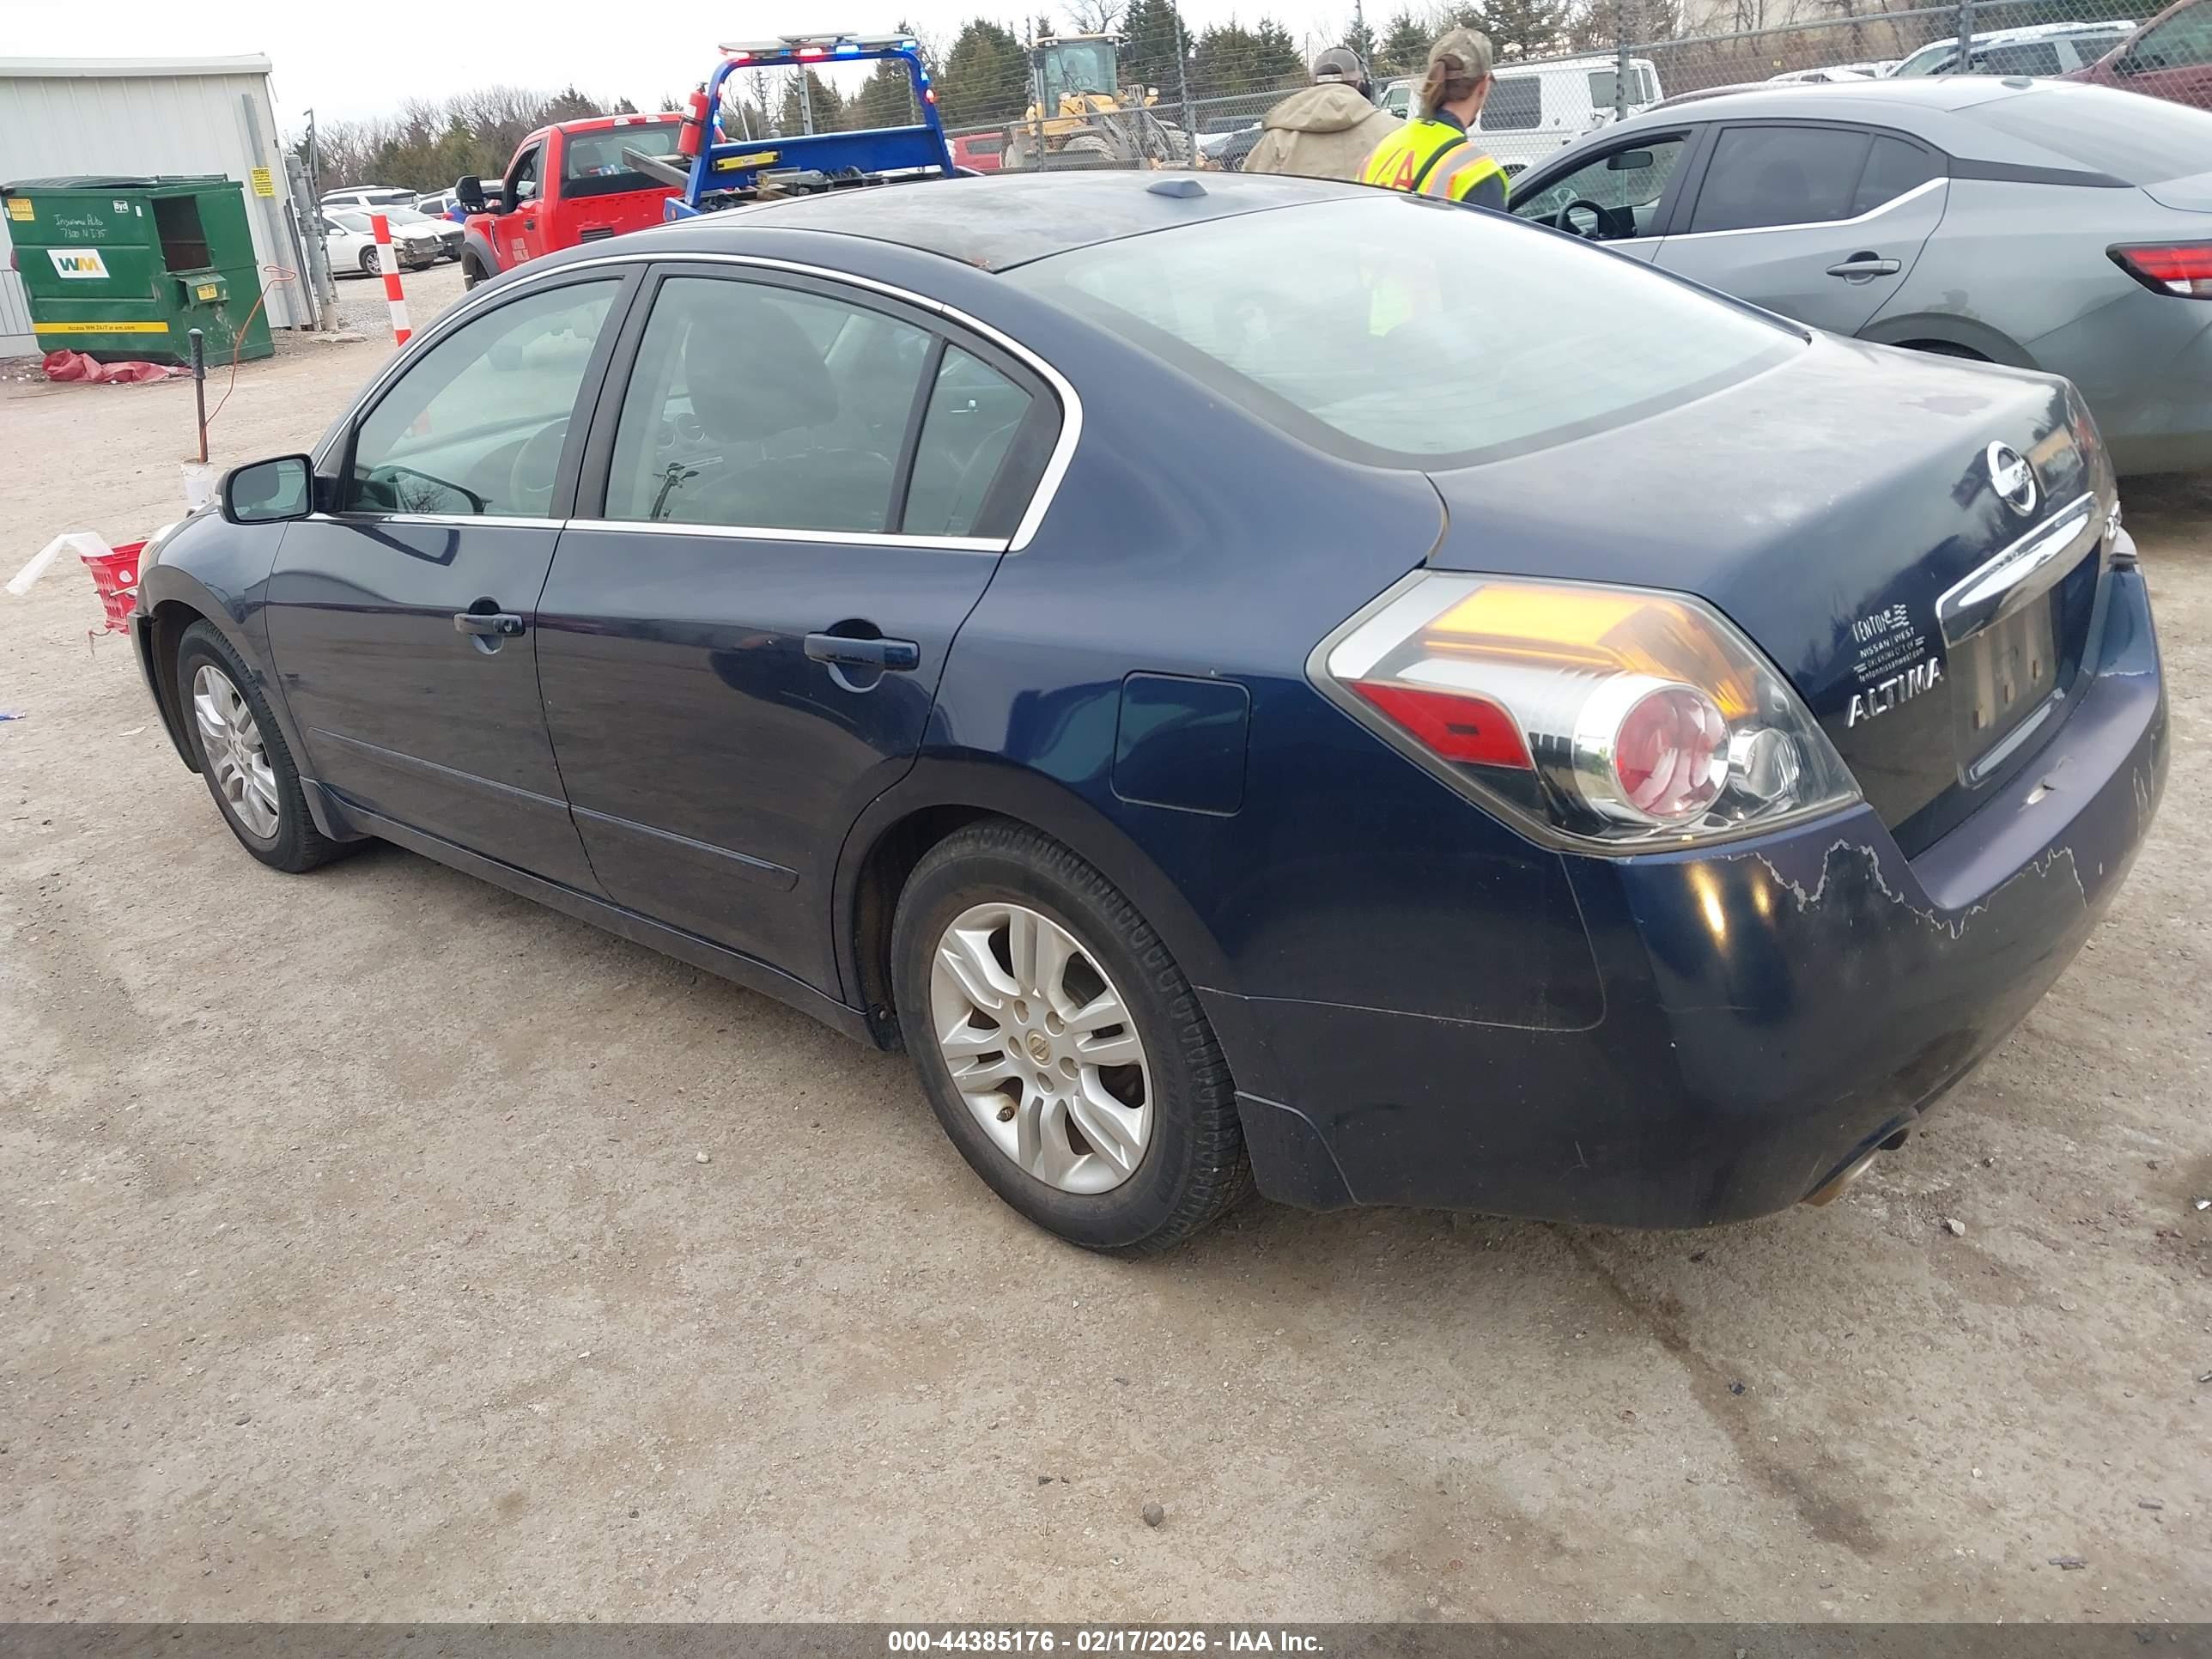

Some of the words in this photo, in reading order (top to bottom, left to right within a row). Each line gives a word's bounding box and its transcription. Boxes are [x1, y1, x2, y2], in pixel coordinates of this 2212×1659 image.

[58, 257, 100, 271] WM
[1860, 639, 1890, 658] NISSAN
[1894, 627, 1915, 642] WEST
[1846, 657, 1944, 728] ALTIMA
